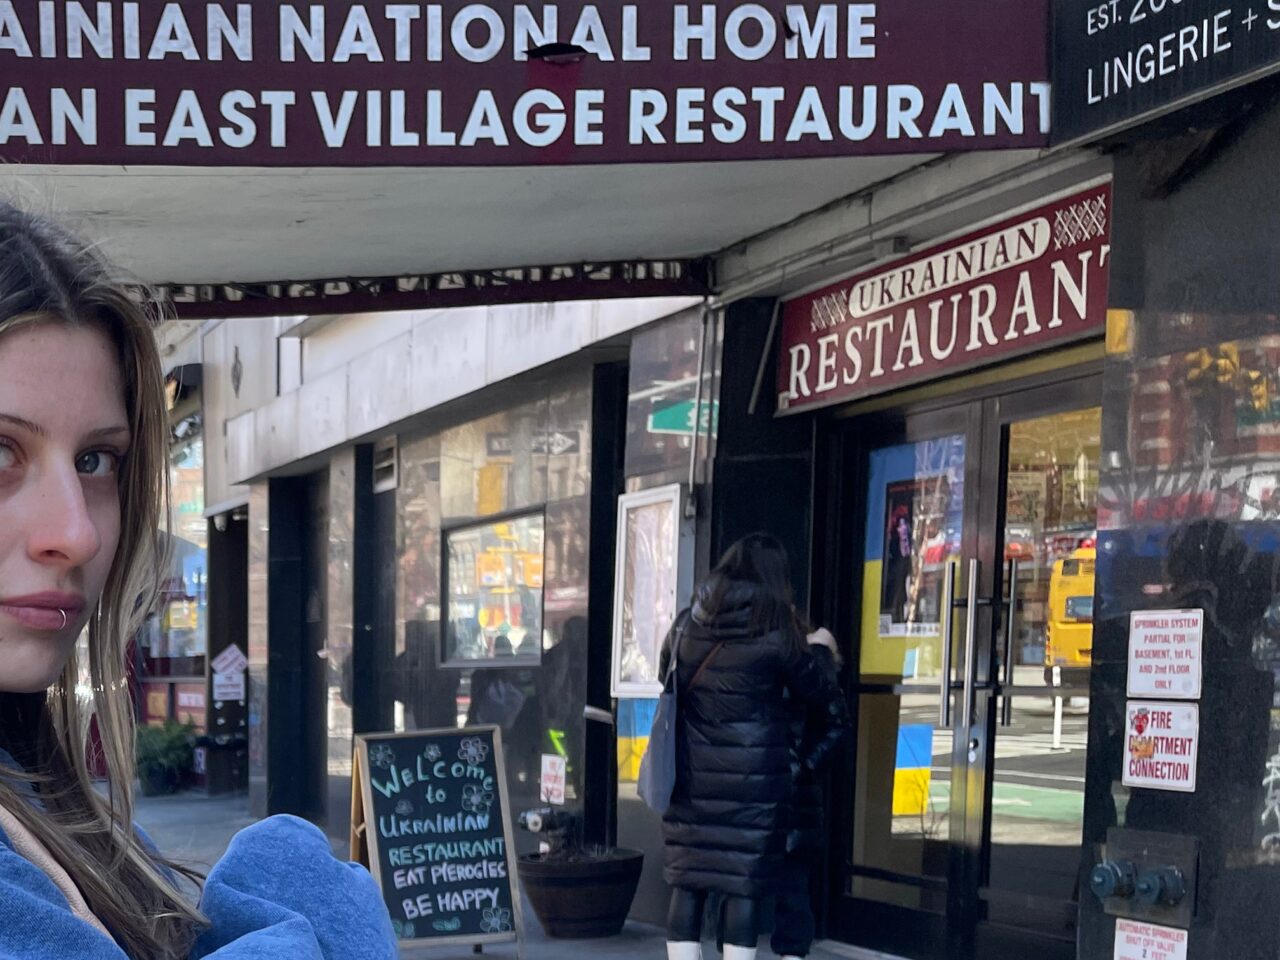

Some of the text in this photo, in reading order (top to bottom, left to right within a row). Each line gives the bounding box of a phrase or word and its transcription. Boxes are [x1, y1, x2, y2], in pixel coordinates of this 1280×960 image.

[280, 3, 651, 62] NATIONAL
[673, 3, 876, 61] HOME
[1087, 0, 1122, 36] EST.
[1087, 9, 1232, 105] LINGERIE
[125, 89, 296, 148] EAST
[311, 89, 605, 148] VILLAGE
[628, 82, 1051, 146] RESTAURANT
[858, 221, 1040, 312] UKRAINIAN
[788, 244, 1111, 400] RESTAURAN
[1144, 633, 1186, 644] PARTIAL FOR
[1171, 617, 1199, 629] SYSTEM
[1139, 664, 1153, 674] AND
[1169, 664, 1190, 675] FLOOR
[1151, 711, 1172, 730] FIRE
[1129, 758, 1190, 782] CONNECTION
[425, 783, 447, 804] to
[388, 836, 505, 867] RESTAURANT
[393, 858, 507, 890] EAT PIEROGIES
[402, 887, 500, 920] BE HAPPY
